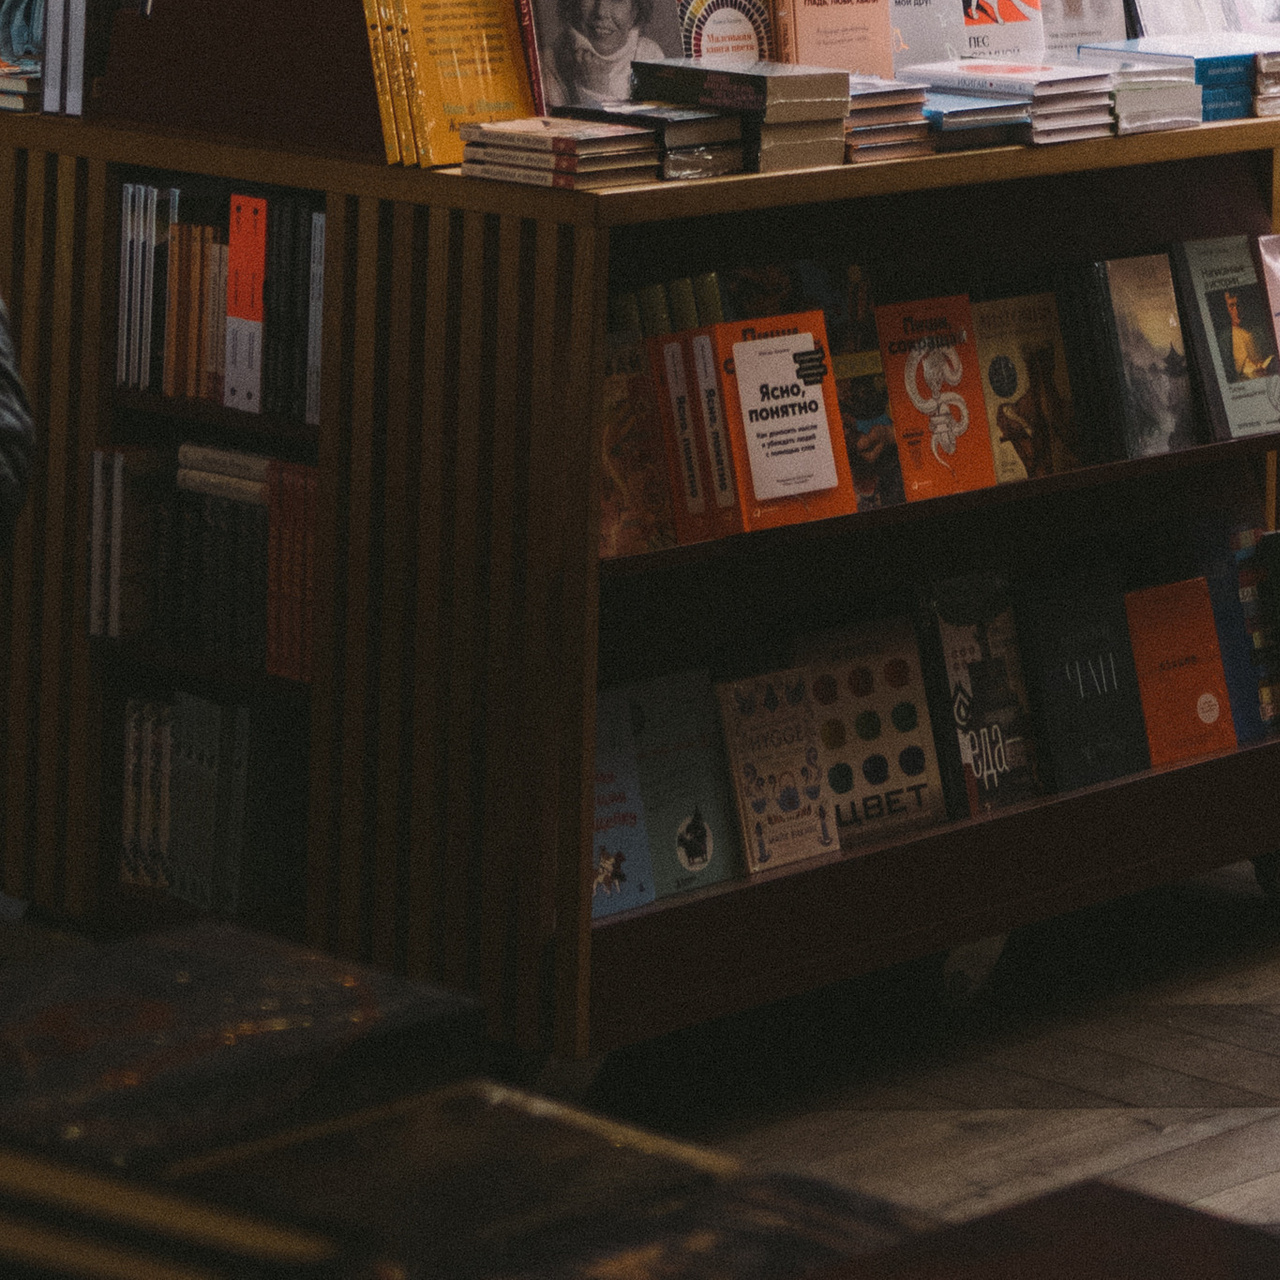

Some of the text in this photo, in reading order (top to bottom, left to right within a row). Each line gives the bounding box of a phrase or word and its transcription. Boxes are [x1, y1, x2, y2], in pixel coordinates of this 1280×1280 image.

[968, 36, 989, 48] ПЕС
[759, 383, 807, 402] Ясно,
[748, 400, 820, 423] понятно
[835, 783, 928, 828] ЦВЕТ
